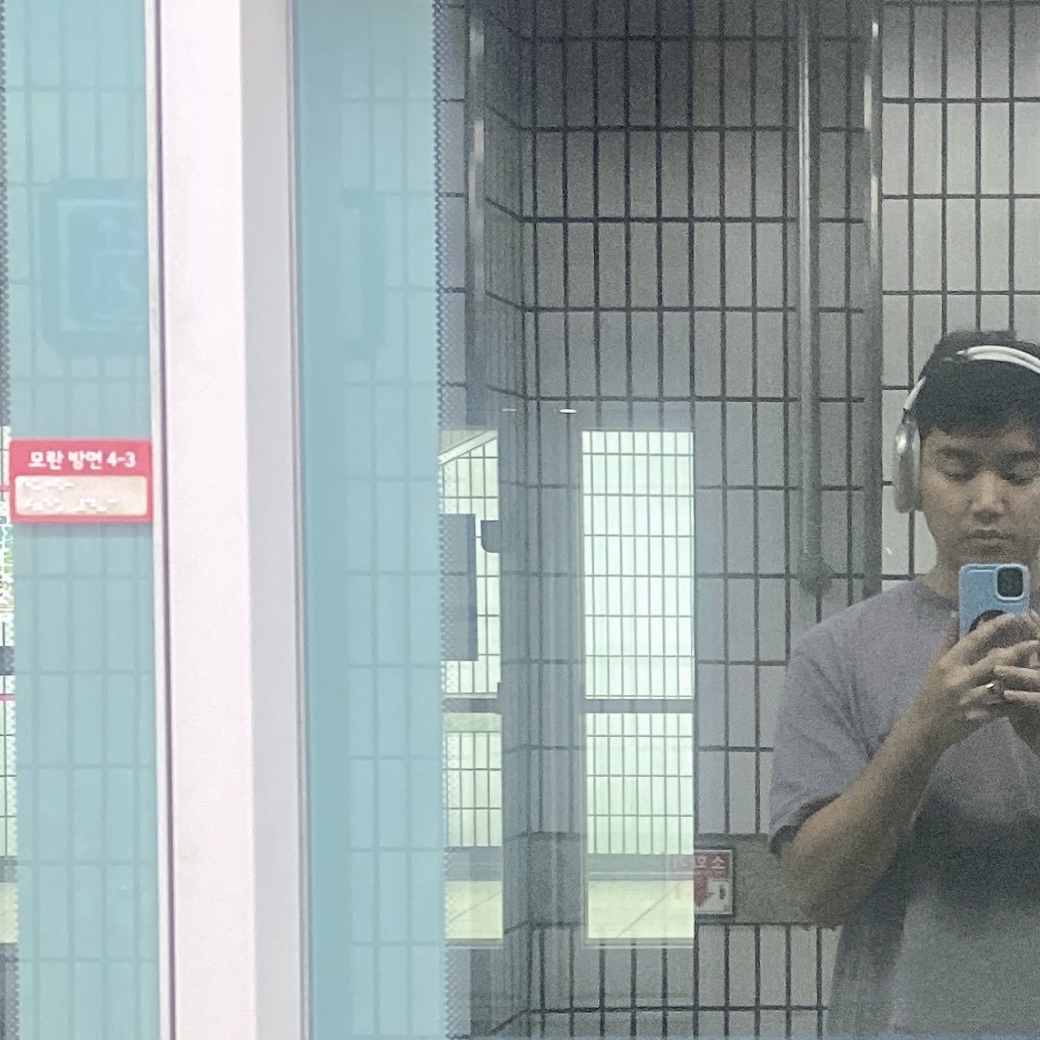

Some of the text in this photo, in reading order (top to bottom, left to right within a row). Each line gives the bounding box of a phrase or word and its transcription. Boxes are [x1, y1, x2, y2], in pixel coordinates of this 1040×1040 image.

[28, 450, 137, 471] 모란 방면 4-3
